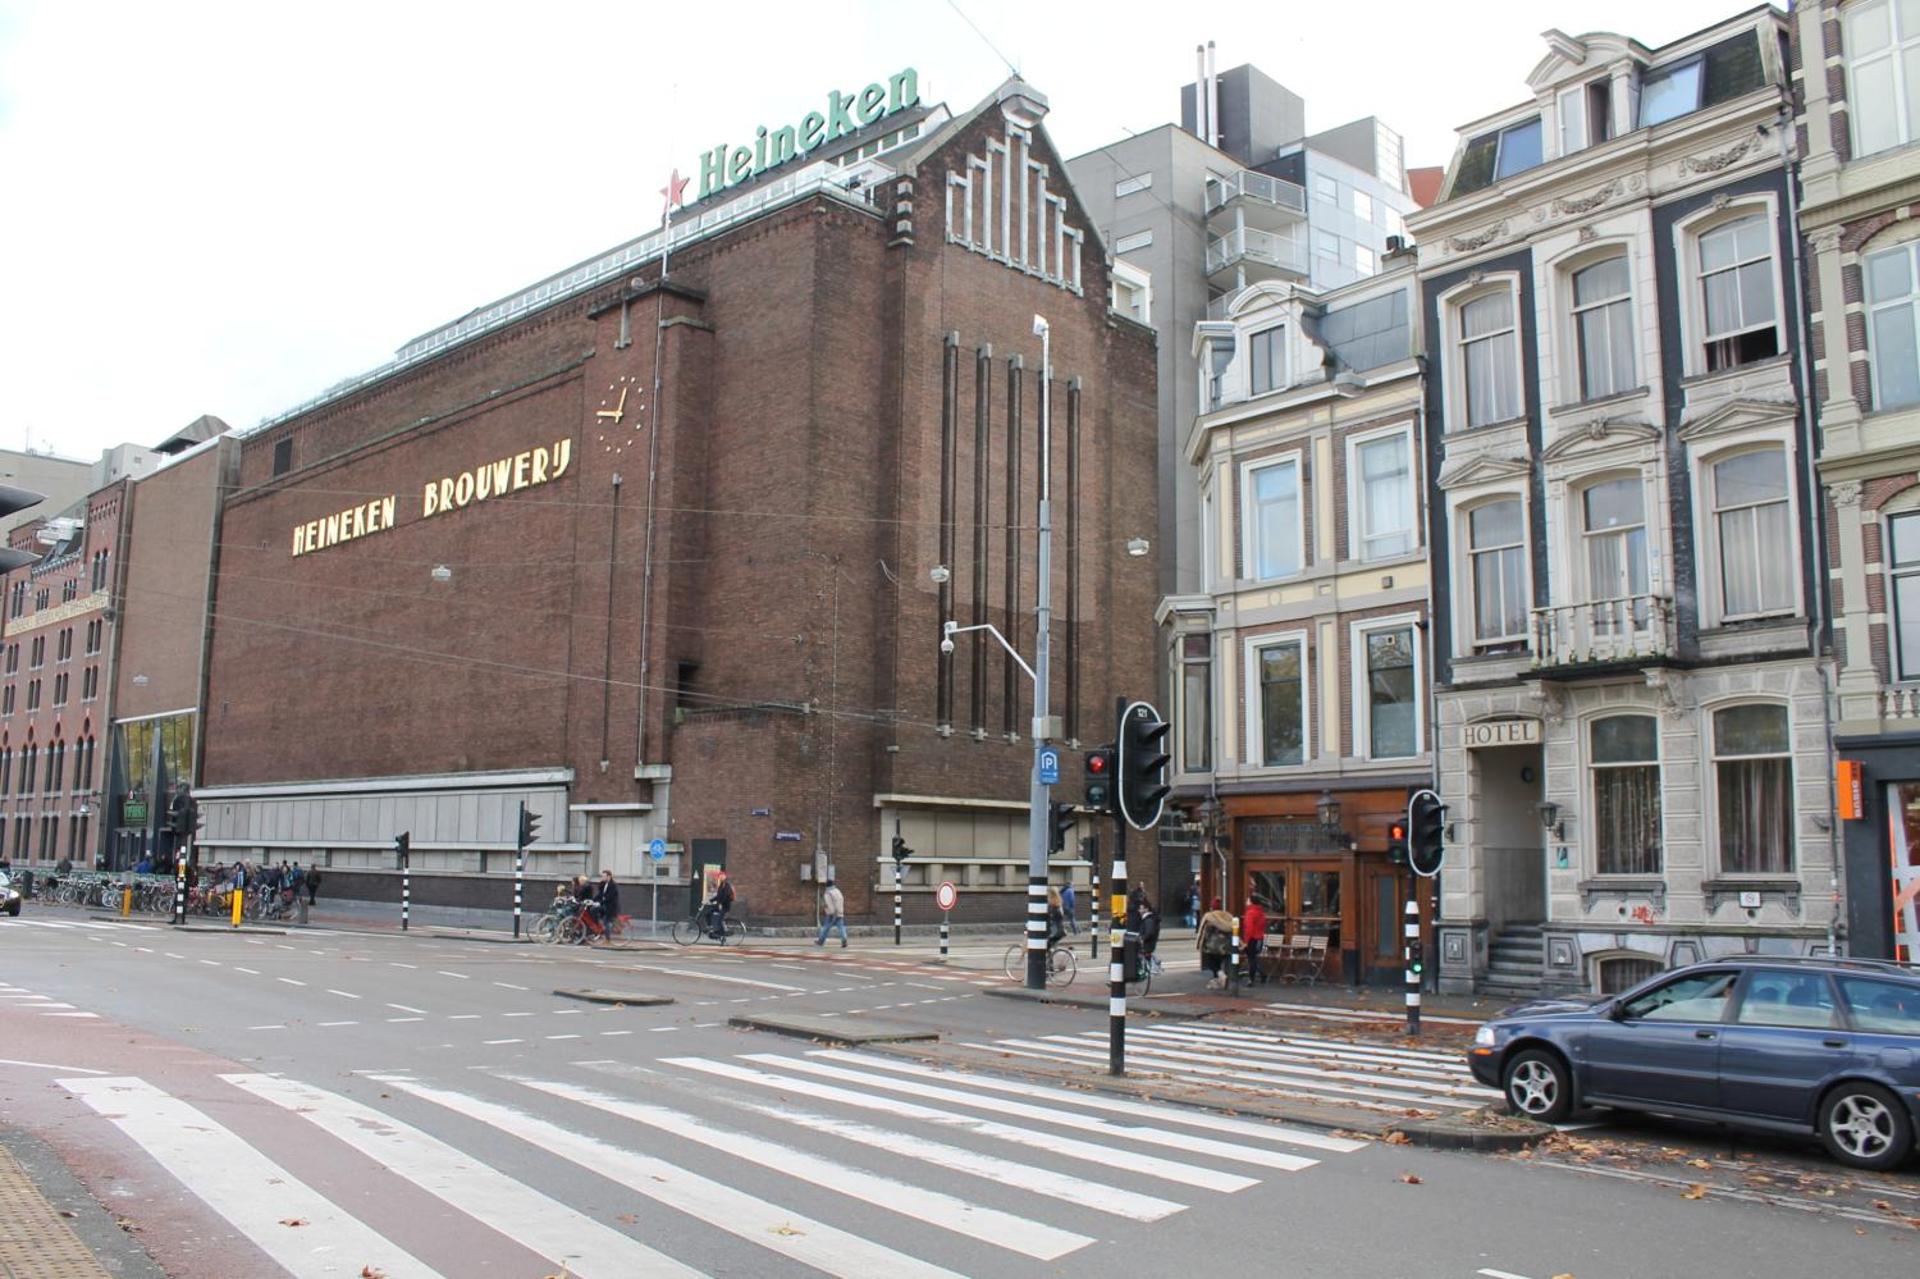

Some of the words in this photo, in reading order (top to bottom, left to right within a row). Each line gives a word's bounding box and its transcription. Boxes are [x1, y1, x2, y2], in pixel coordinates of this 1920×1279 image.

[697, 67, 920, 201] Heineken
[292, 494, 396, 556] HEINEKEN
[1464, 722, 1535, 745] HOTEL
